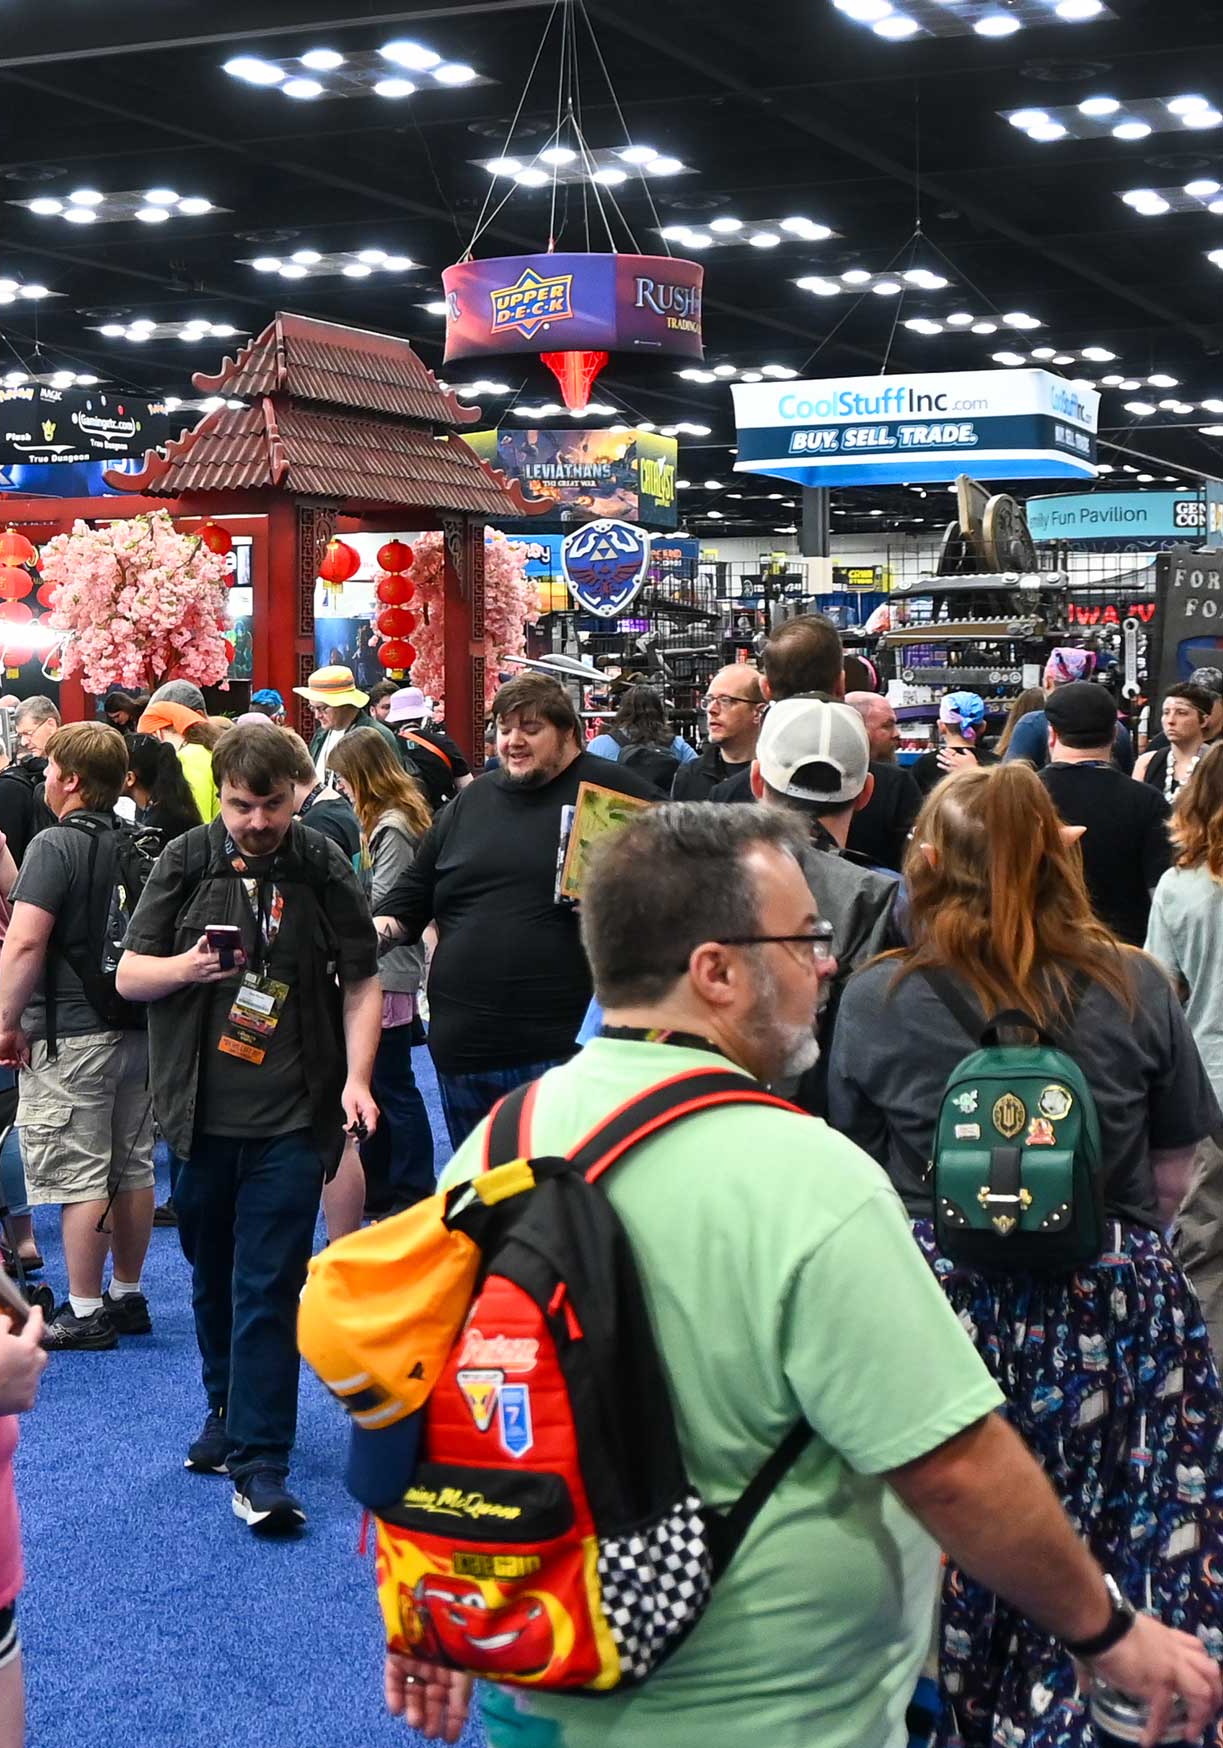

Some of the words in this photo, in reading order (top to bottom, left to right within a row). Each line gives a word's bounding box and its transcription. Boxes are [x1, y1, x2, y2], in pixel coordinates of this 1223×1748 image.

[495, 285, 564, 311] UPPER
[790, 429, 839, 453] BUY.
[841, 426, 896, 449] SELL.
[899, 422, 979, 446] TRADE.
[28, 455, 50, 464] True
[50, 454, 90, 464] Dungeon
[526, 463, 611, 480] LEVIATHANS
[1052, 511, 1075, 526] Fun
[1080, 508, 1147, 524] Pavilion
[505, 1405, 521, 1425] 7
